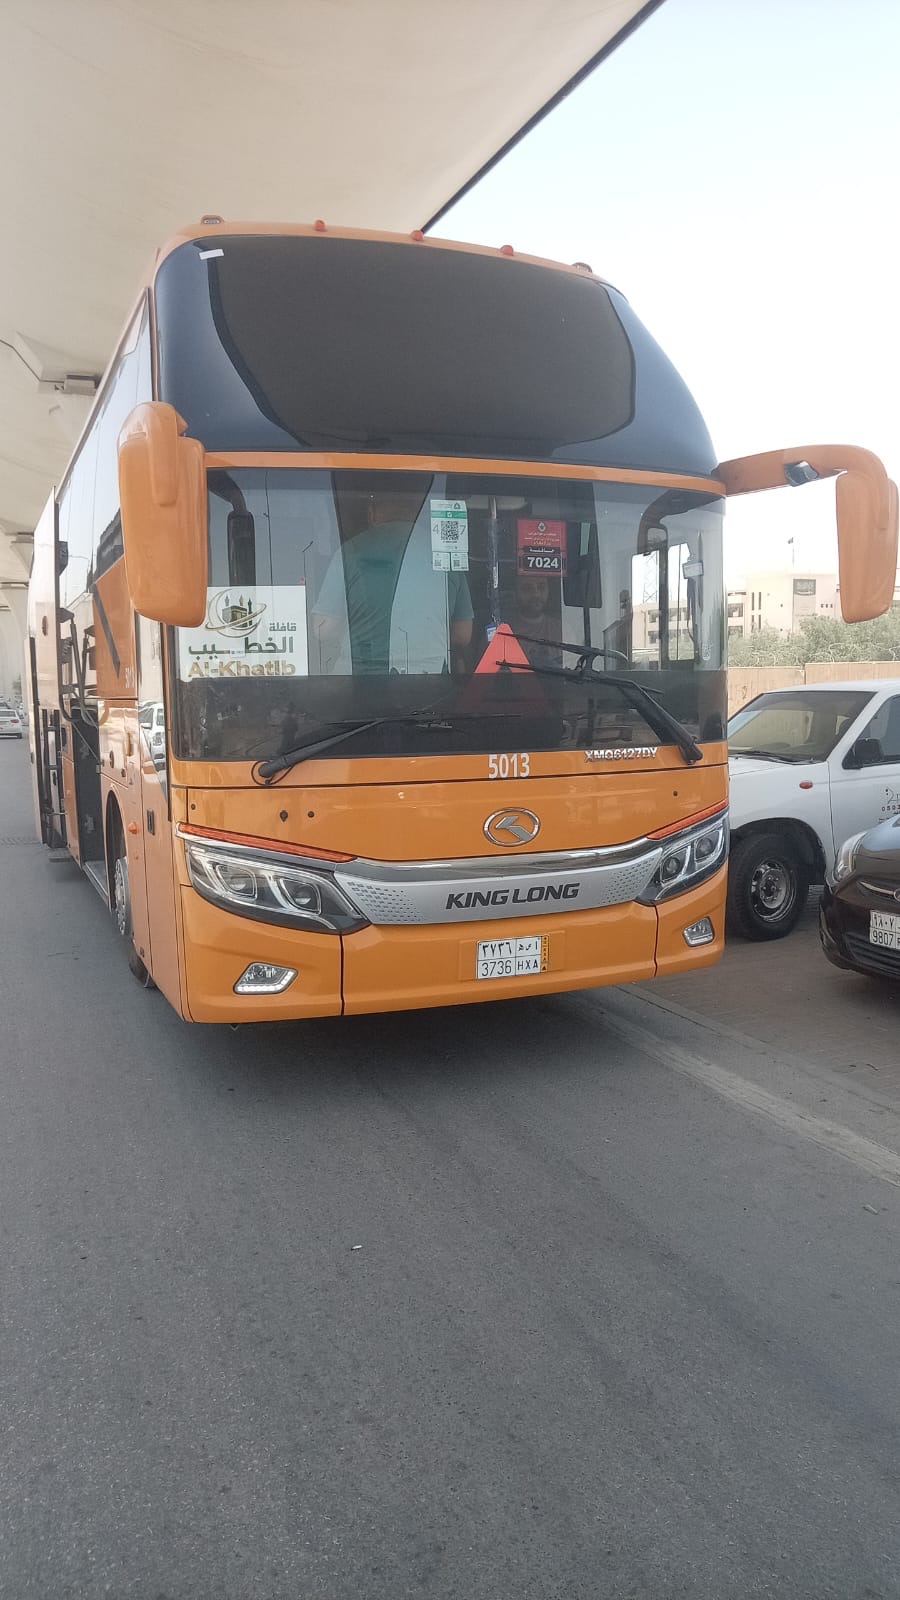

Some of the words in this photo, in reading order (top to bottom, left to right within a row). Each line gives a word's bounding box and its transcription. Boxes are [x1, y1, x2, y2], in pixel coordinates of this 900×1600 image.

[527, 556, 559, 569] 7024
[269, 622, 297, 632] قافلة
[188, 636, 294, 660] الخطيب
[584, 747, 658, 763] XMQ6127DY
[488, 752, 530, 779] 5013
[446, 889, 509, 910] KING
[512, 882, 580, 904] LONG
[872, 930, 894, 946] 9807
[482, 941, 512, 958] ٣٧٣٦
[481, 959, 512, 977] 3736
